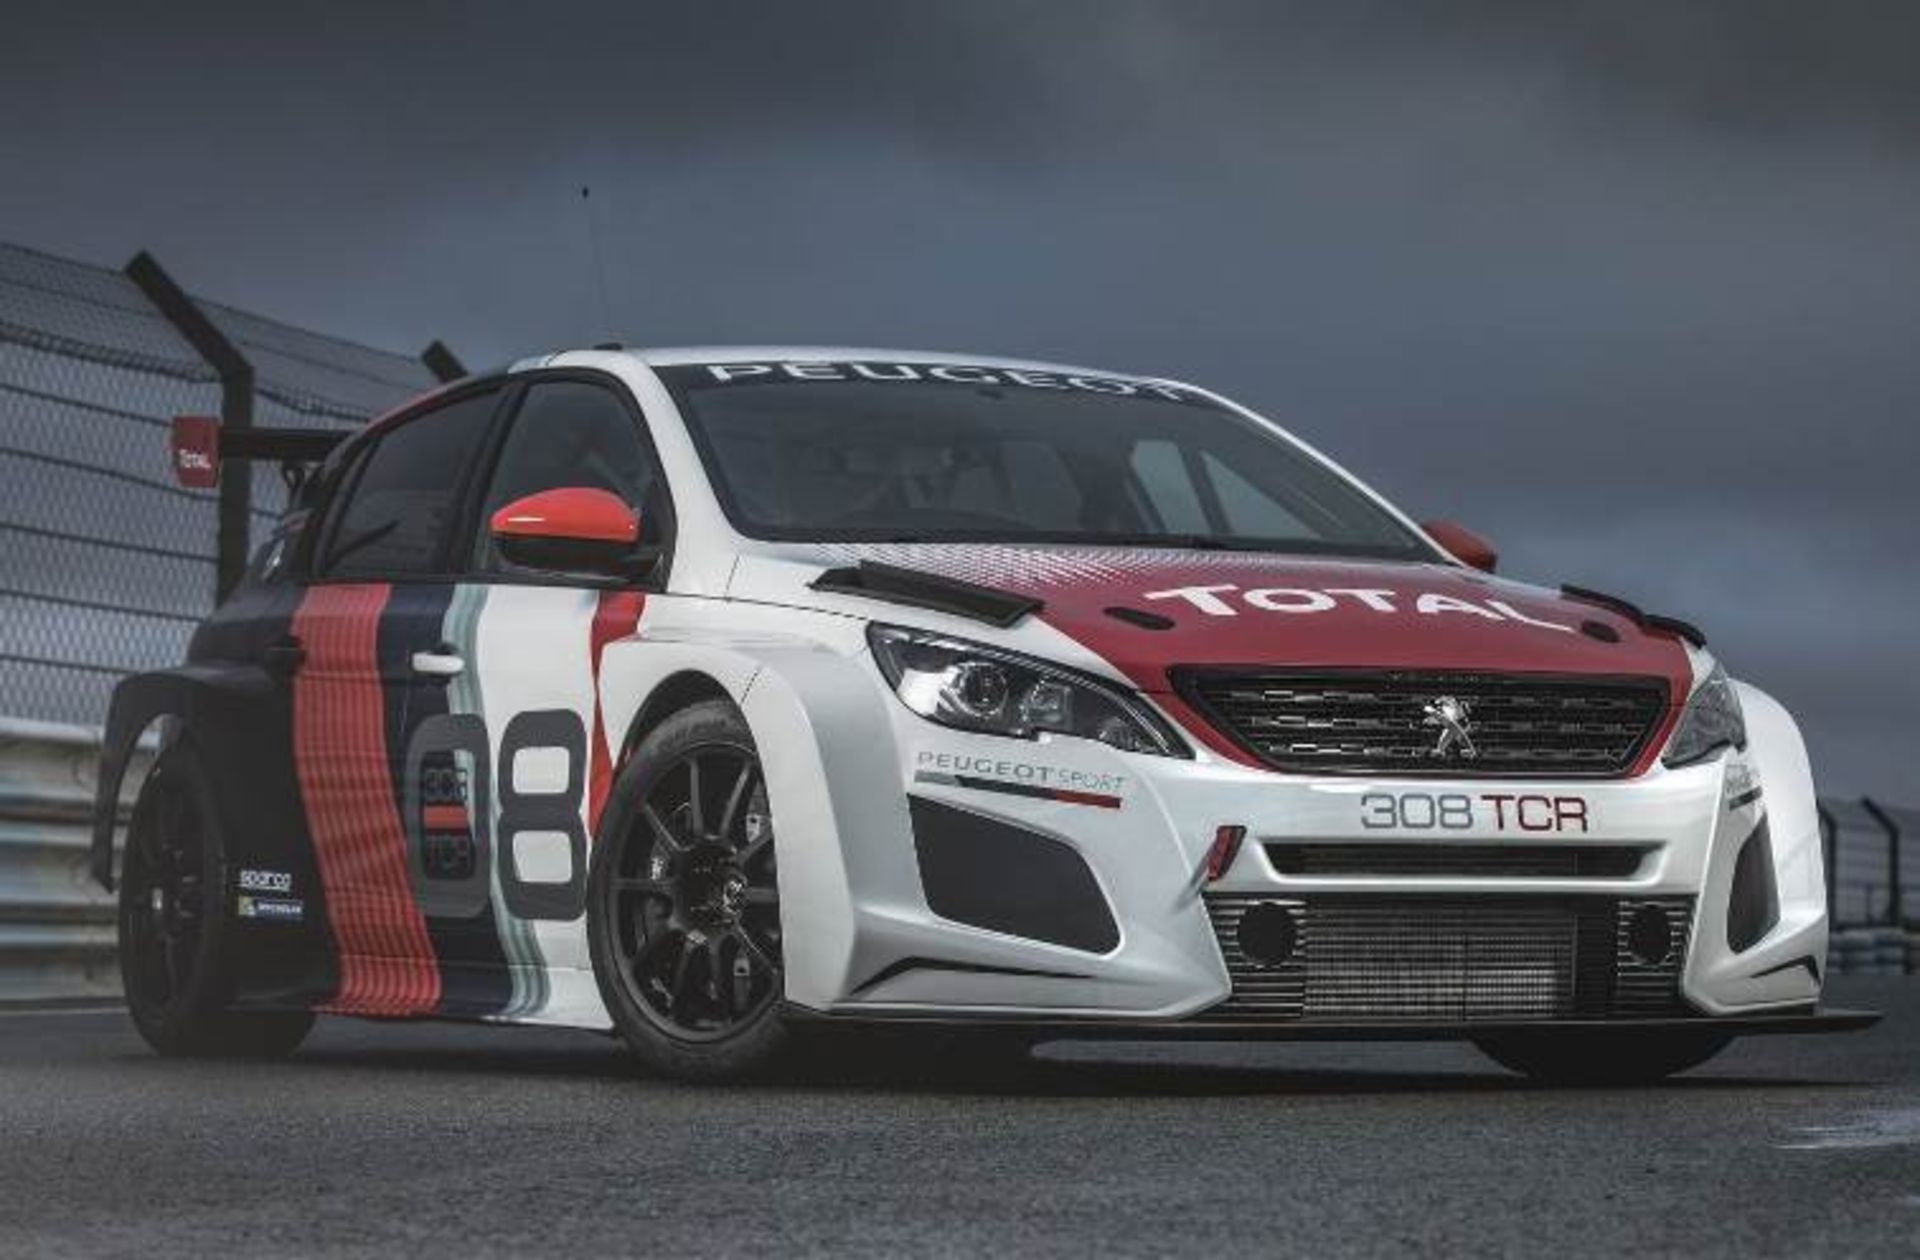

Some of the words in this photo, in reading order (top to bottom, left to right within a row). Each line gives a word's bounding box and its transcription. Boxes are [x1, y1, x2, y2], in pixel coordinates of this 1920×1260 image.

[706, 361, 1186, 400] PEUGEOT
[1144, 584, 1576, 633] TOTAL
[918, 751, 1055, 782] PEUGEOT
[1057, 768, 1128, 791] SPORT
[1361, 794, 1474, 829] 308
[1480, 794, 1588, 833] TCR
